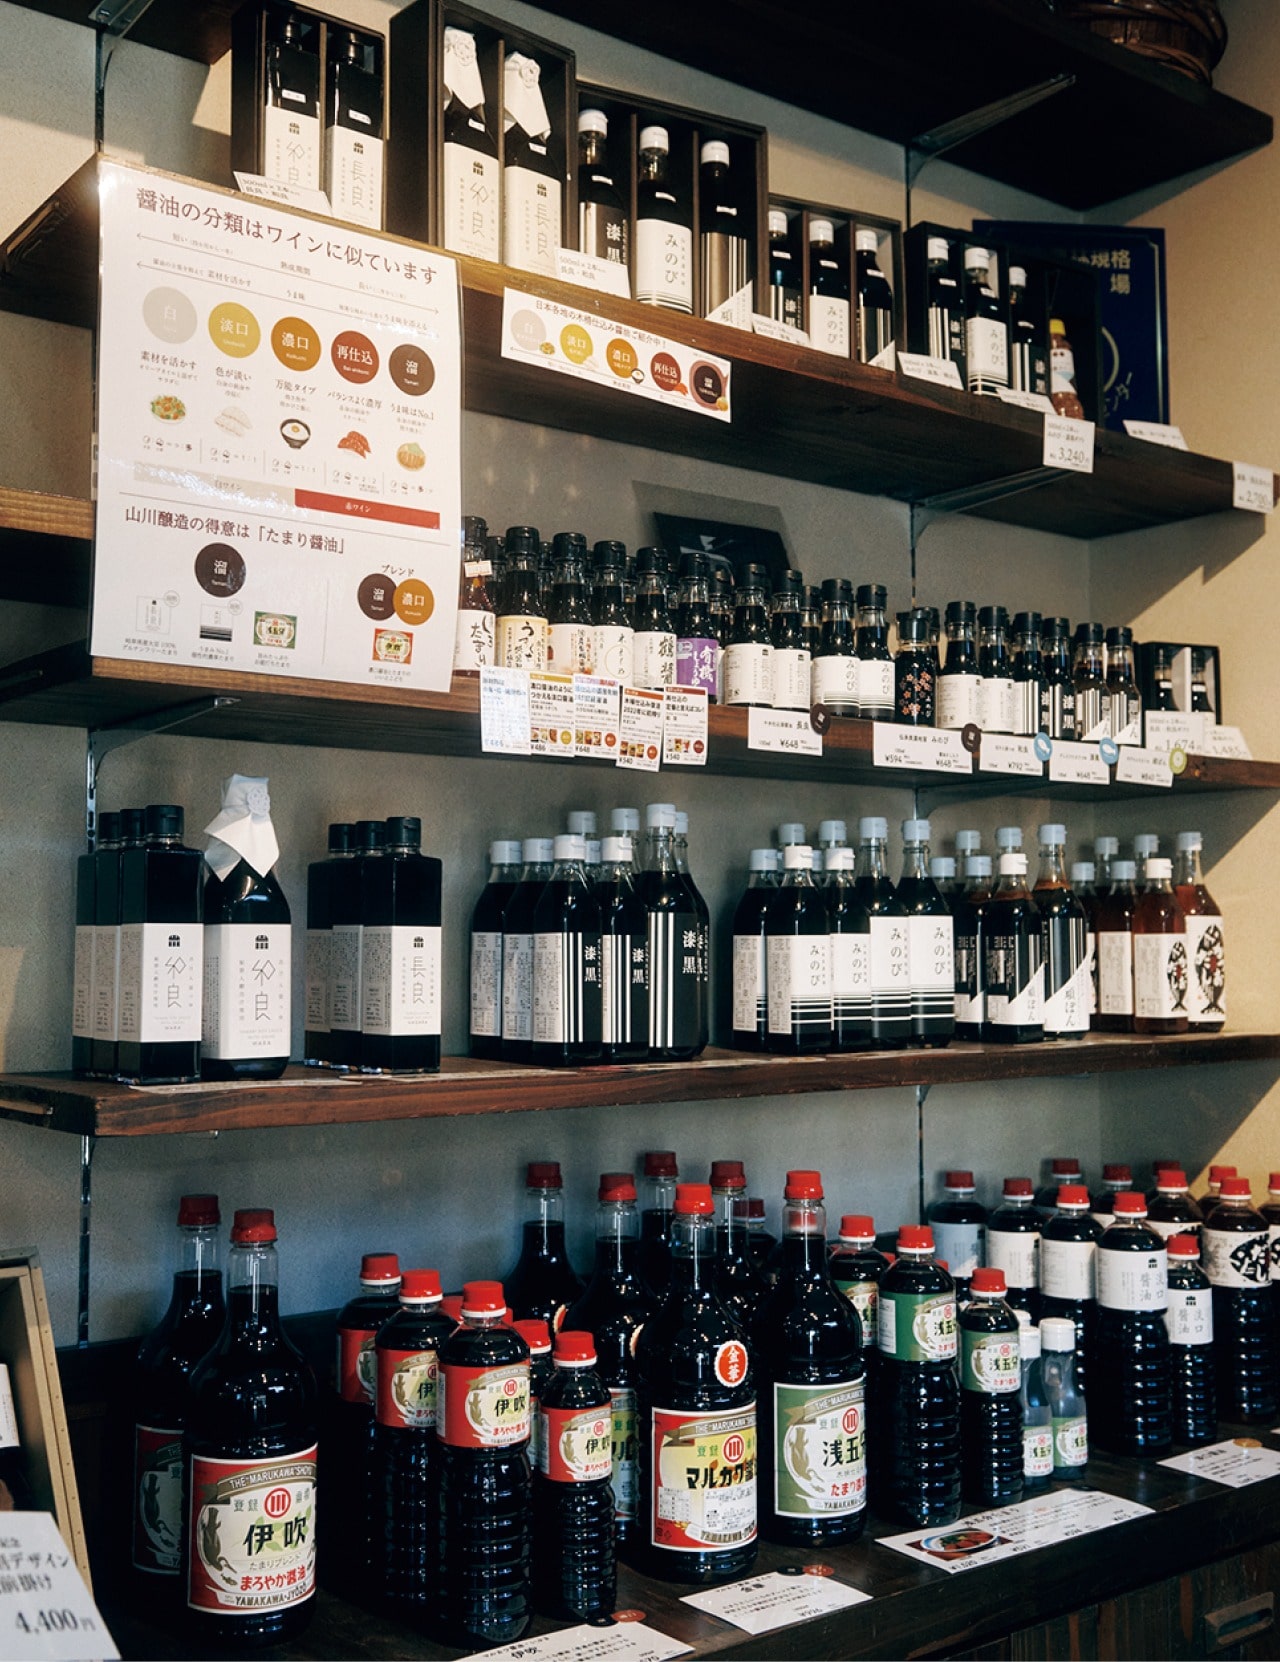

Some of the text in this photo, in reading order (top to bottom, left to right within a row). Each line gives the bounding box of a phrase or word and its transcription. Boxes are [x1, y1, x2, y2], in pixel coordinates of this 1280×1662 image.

[136, 187, 438, 285] 醤油の分類はワインに似ています
[665, 233, 678, 283] みのび
[219, 317, 249, 337] 淡口
[827, 306, 838, 344] みのび
[281, 331, 309, 351] 濃口
[566, 334, 587, 350] 淡口
[990, 329, 999, 365] みのび
[141, 350, 197, 370] 素材を活かす
[336, 344, 374, 366] 再仕込
[612, 347, 631, 364] 濃口
[215, 366, 252, 381] 色が淡い
[405, 359, 419, 376] 溜
[653, 360, 678, 379] 再仕込
[274, 378, 317, 395] 万能タイプ
[327, 390, 383, 410] バランスよく濃厚
[390, 402, 435, 421] うま味はNo.1
[345, 501, 372, 513] 赤ワイン
[125, 505, 345, 555] 山川醸造の得意は「たまり醤油」
[213, 559, 228, 575] 溜
[381, 563, 415, 577] ブレンド
[372, 587, 385, 602] 溜
[402, 591, 425, 607] 濃口
[779, 739, 799, 749] ¥648
[931, 736, 949, 745] みのび
[884, 754, 903, 764] ¥594
[1007, 761, 1023, 771] ¥792
[682, 930, 697, 974] 漆黒
[890, 927, 903, 977] みのび
[934, 926, 946, 975] みのび
[584, 945, 597, 982] 漆黒
[632, 947, 645, 984] 漆黒
[809, 944, 821, 987] みのび
[852, 943, 862, 984] みのび
[494, 1396, 526, 1417] 伊吹
[229, 1476, 247, 1489] THE
[233, 1498, 259, 1513] 登録
[242, 1515, 307, 1557] 伊吹
[249, 1554, 301, 1571] たまりブレンド
[240, 1564, 306, 1592] まろやか醤油
